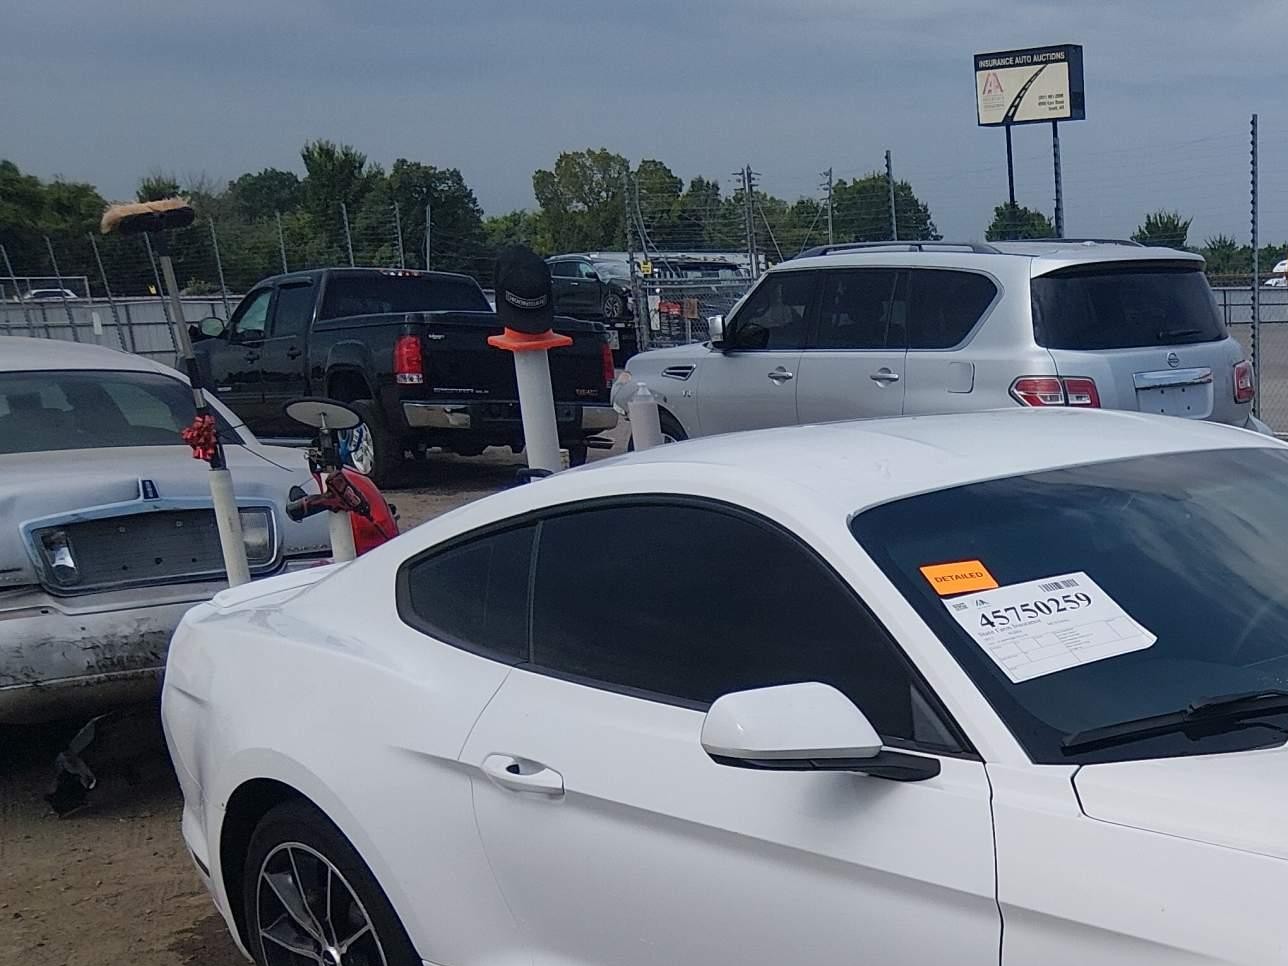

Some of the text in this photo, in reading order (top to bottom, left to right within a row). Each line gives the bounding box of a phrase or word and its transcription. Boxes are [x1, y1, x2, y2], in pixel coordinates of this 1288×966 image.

[978, 51, 1065, 68] INSURANCE AUTO AUCTIONS
[933, 571, 984, 583] DETAILED
[980, 592, 1092, 628] 45750259
